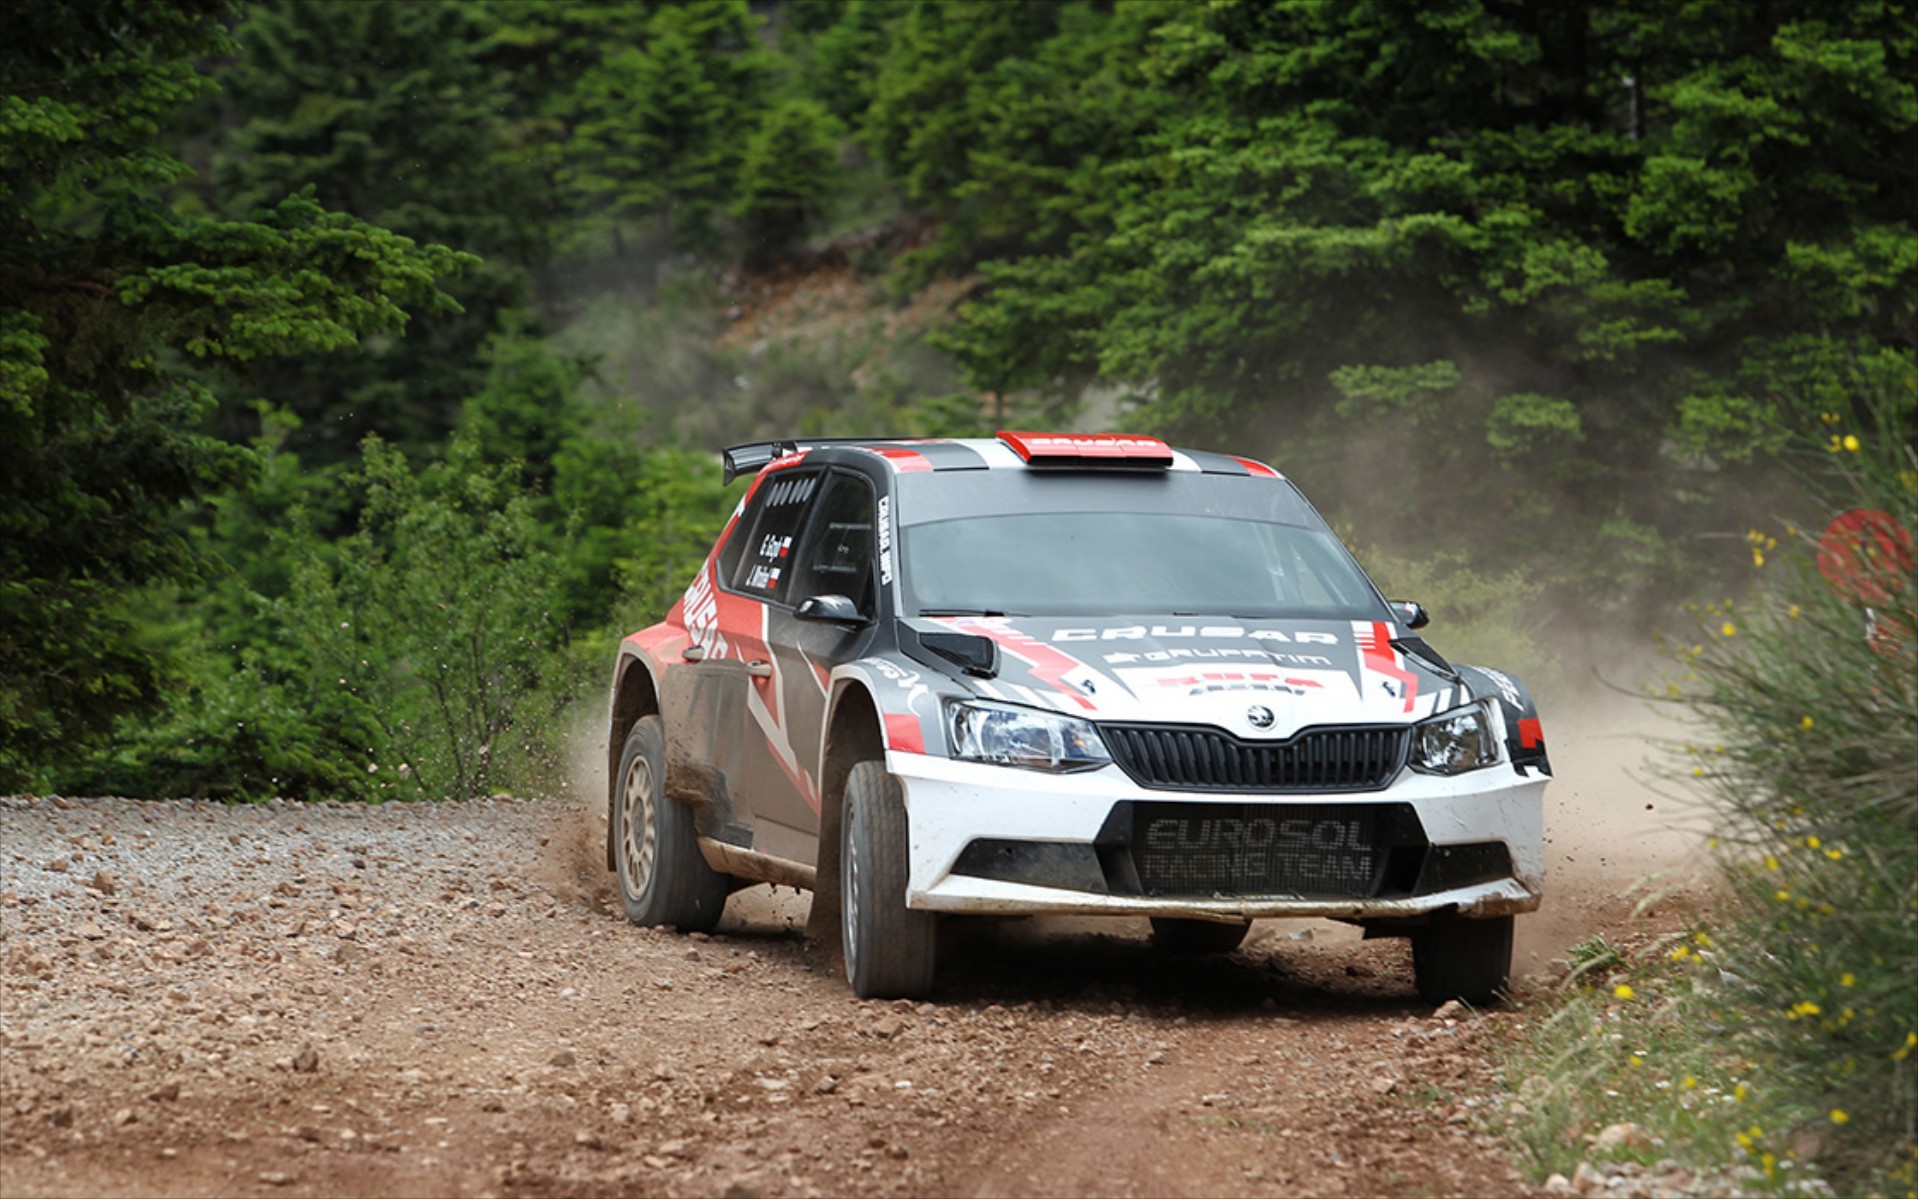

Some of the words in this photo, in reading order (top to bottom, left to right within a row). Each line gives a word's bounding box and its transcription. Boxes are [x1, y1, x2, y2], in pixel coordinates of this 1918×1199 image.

[1051, 626, 1339, 645] CRUSAR
[1147, 818, 1372, 851] EUROSOL
[1145, 852, 1267, 878] RACING
[1277, 852, 1372, 880] TEAM
